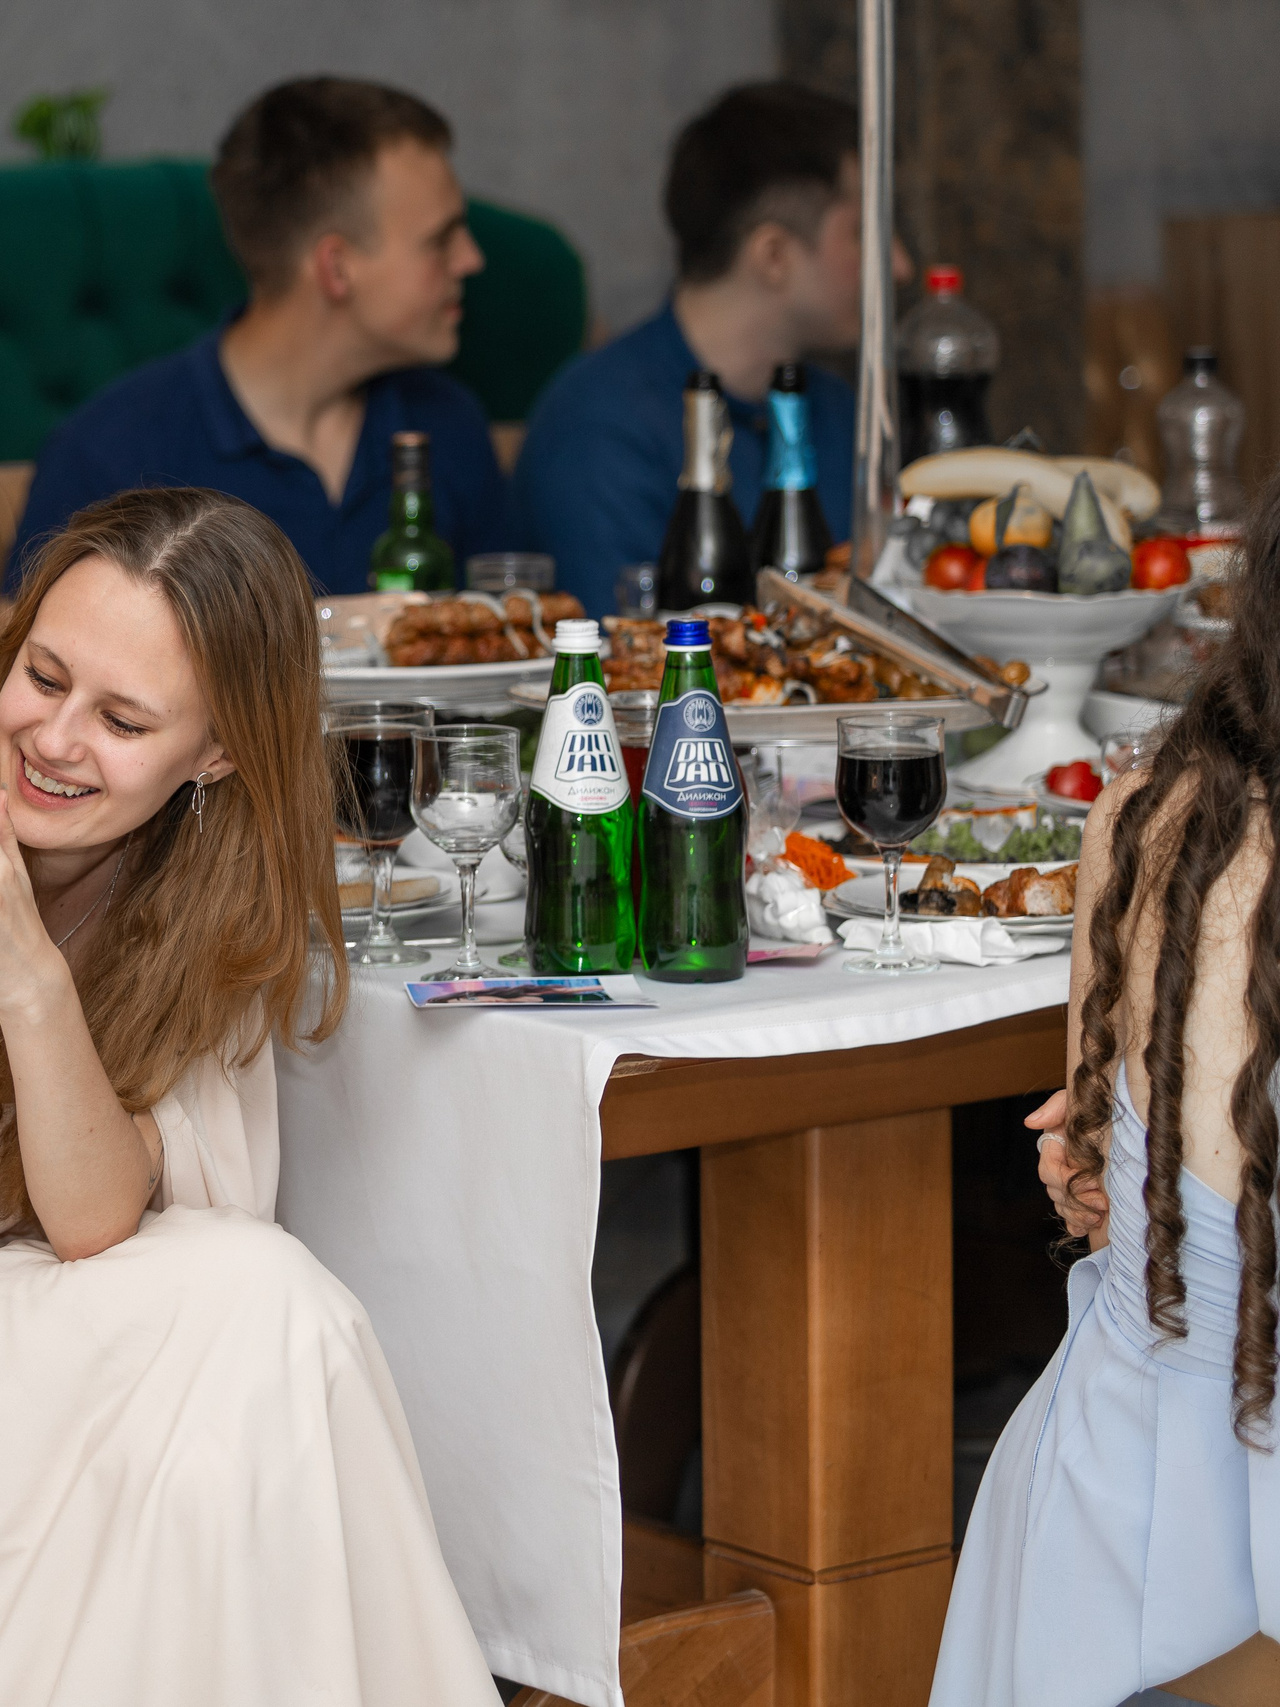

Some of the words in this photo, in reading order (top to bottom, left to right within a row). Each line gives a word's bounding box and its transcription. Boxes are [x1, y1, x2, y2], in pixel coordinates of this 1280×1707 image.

[568, 733, 611, 753] DILI
[677, 742, 724, 762] DILI
[559, 753, 617, 774] JAN
[668, 761, 730, 783] JAN
